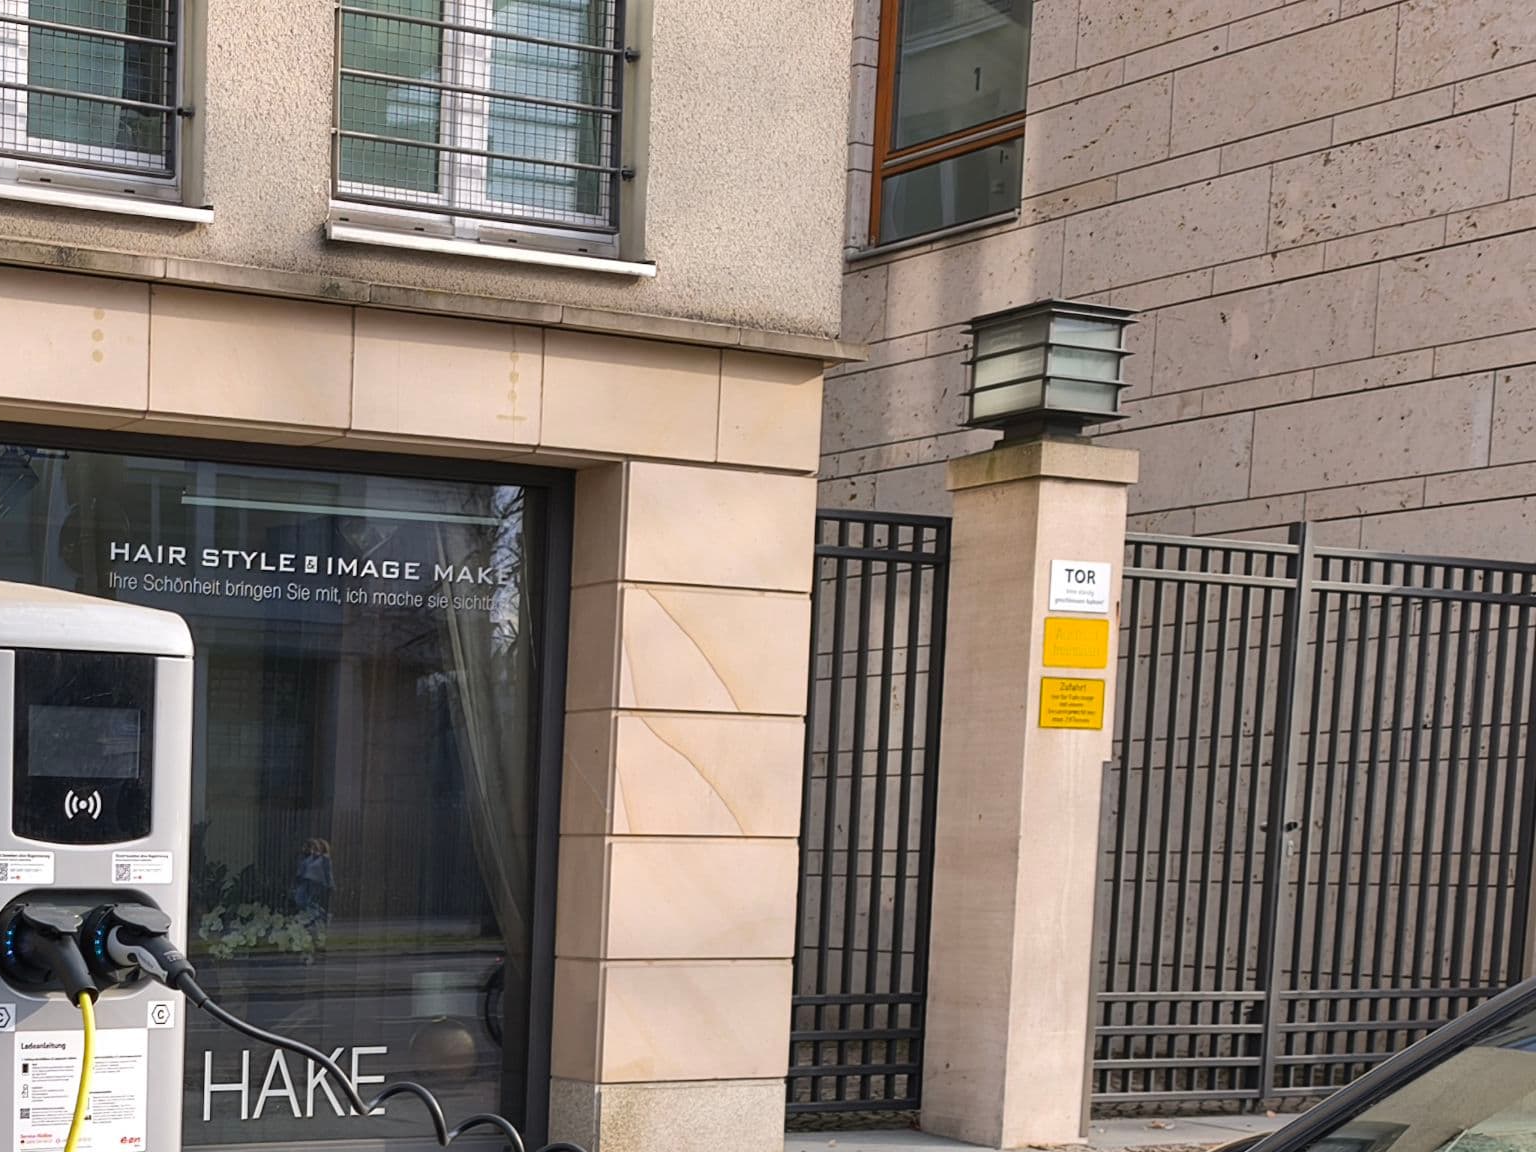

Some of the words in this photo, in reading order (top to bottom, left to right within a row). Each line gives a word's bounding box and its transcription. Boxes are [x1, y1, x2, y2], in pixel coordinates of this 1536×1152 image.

[109, 541, 187, 566] HAIR
[201, 548, 296, 572] STYLE
[326, 556, 421, 581] IMAGE
[434, 563, 521, 585] MAKE
[1064, 568, 1096, 585] TOR
[109, 571, 138, 590] Ihre
[143, 573, 221, 596] Schönheit
[225, 580, 282, 602] bringen
[286, 582, 311, 601] Sie
[315, 586, 341, 605] mit,
[346, 588, 368, 604] ich
[372, 589, 423, 609] mache
[427, 593, 449, 609] sie
[453, 593, 495, 611] sichtb
[203, 1046, 388, 1121] HAKE
